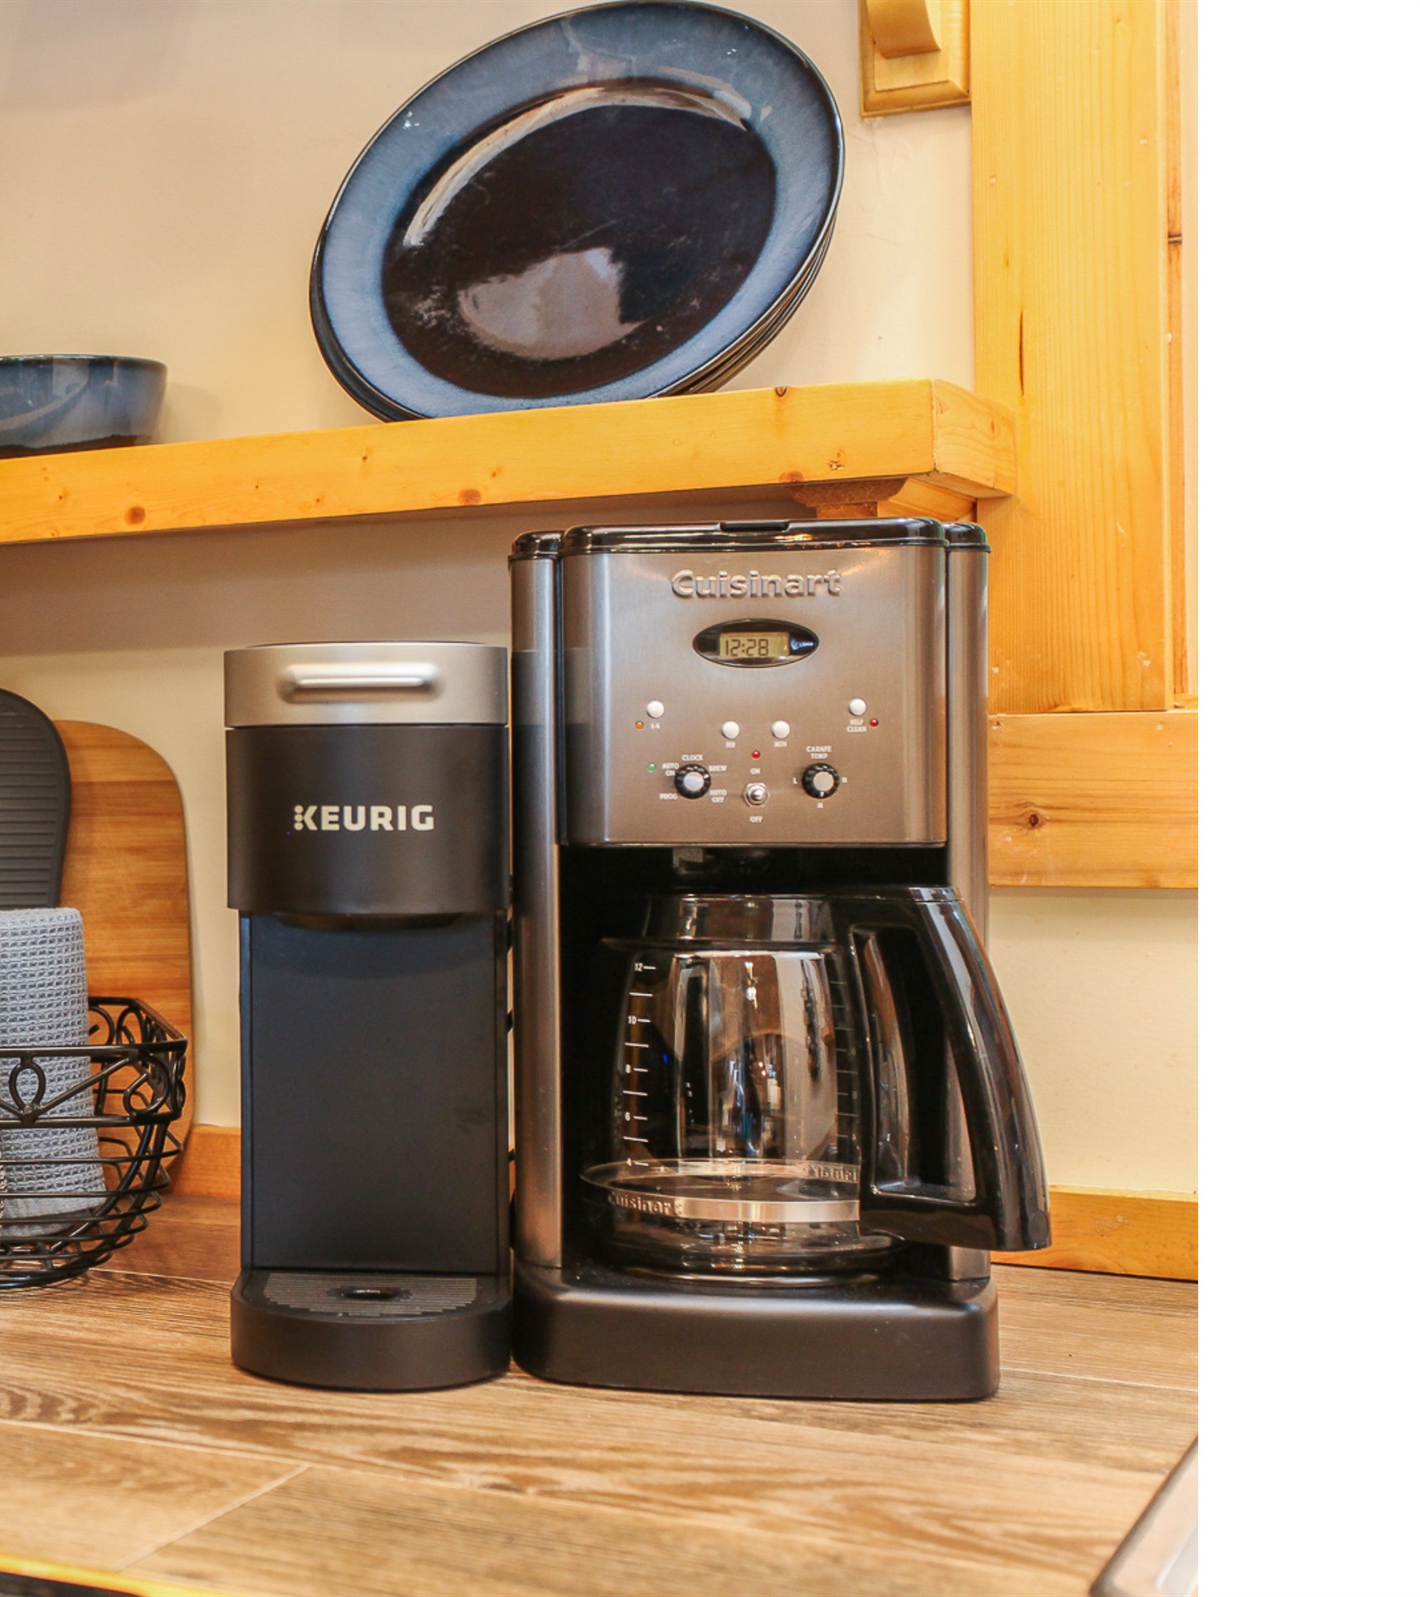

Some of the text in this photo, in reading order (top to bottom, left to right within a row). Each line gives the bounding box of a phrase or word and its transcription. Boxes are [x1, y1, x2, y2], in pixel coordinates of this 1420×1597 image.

[671, 569, 842, 598] Cuisinart
[725, 638, 769, 657] 12:28
[681, 754, 704, 762] CLOCK
[750, 767, 761, 775] ON
[659, 792, 678, 800] PROG
[293, 804, 435, 832] KEURIG
[749, 815, 763, 823] OFF
[634, 962, 643, 972] 12
[627, 1015, 637, 1025] 10
